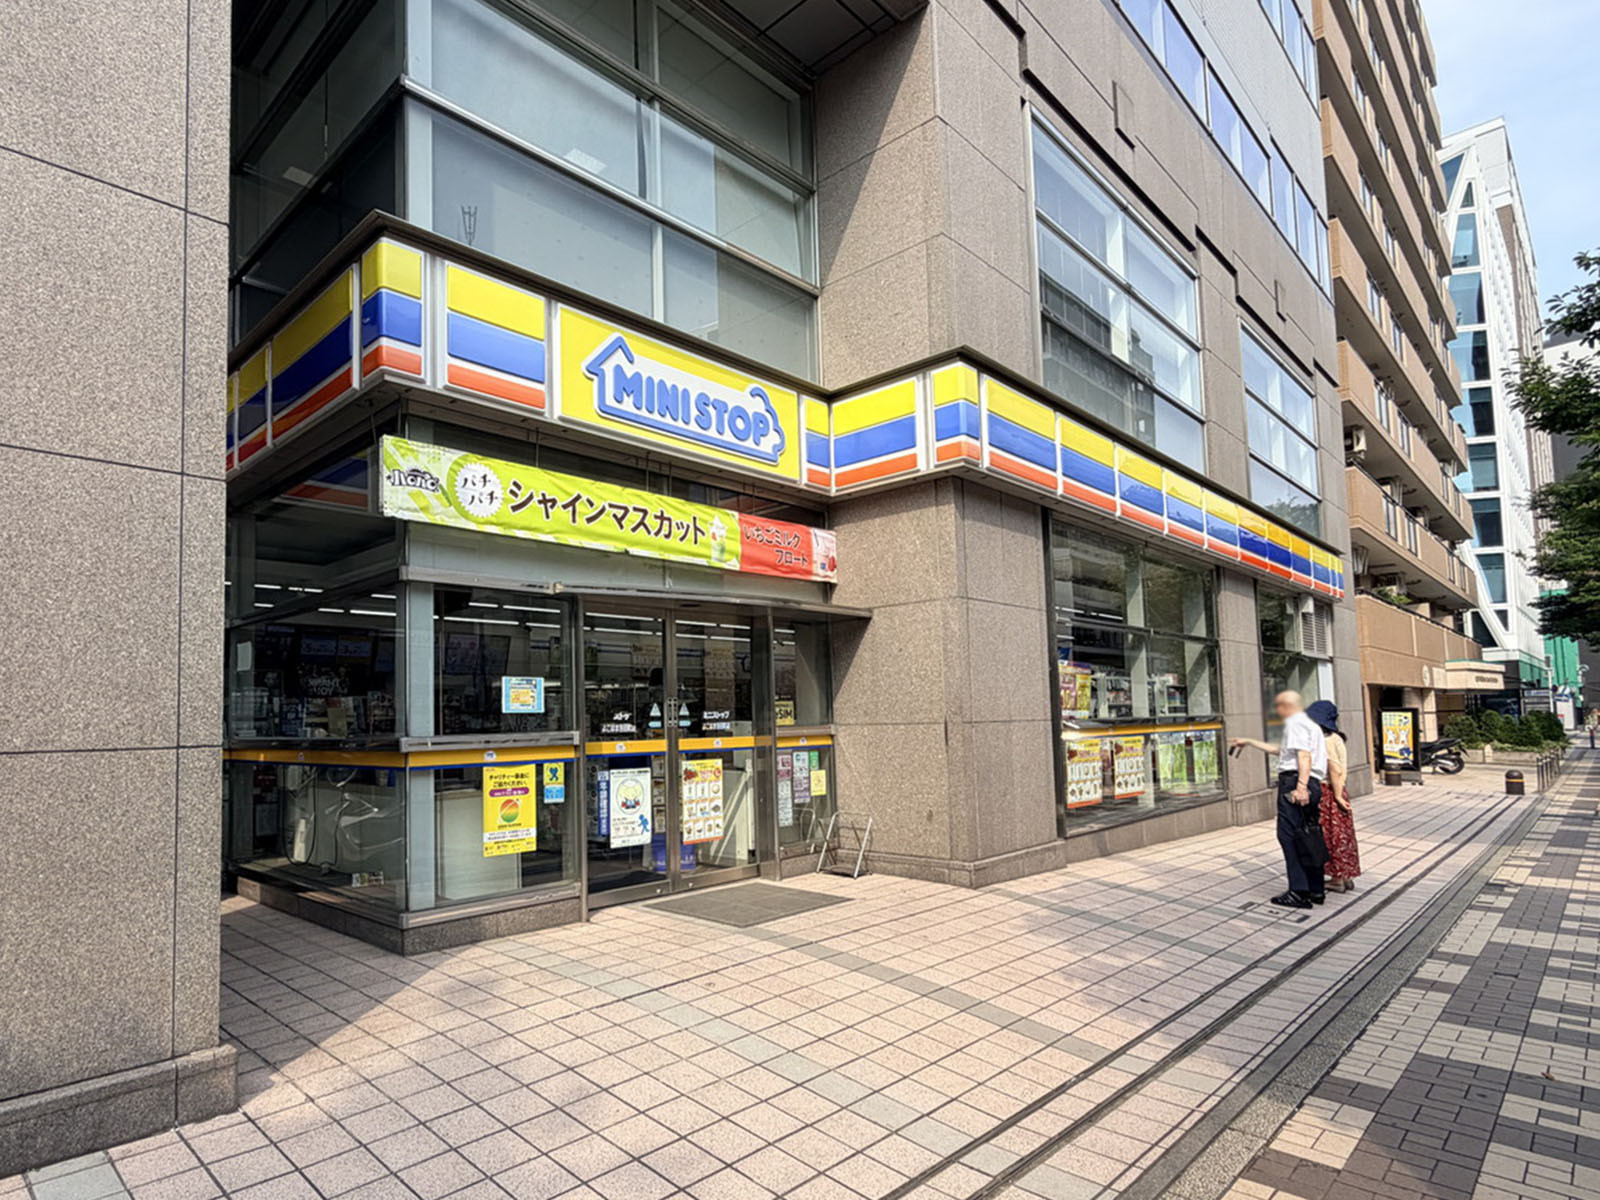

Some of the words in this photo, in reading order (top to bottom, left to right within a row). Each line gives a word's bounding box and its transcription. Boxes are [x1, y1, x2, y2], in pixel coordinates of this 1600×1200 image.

[613, 364, 690, 425] MINI
[695, 391, 770, 446] STOP
[462, 473, 491, 488] パチ
[468, 490, 498, 505] パチ
[508, 480, 706, 545] シャインマスカット
[743, 525, 801, 548] いちごミルク
[775, 549, 809, 565] フロート
